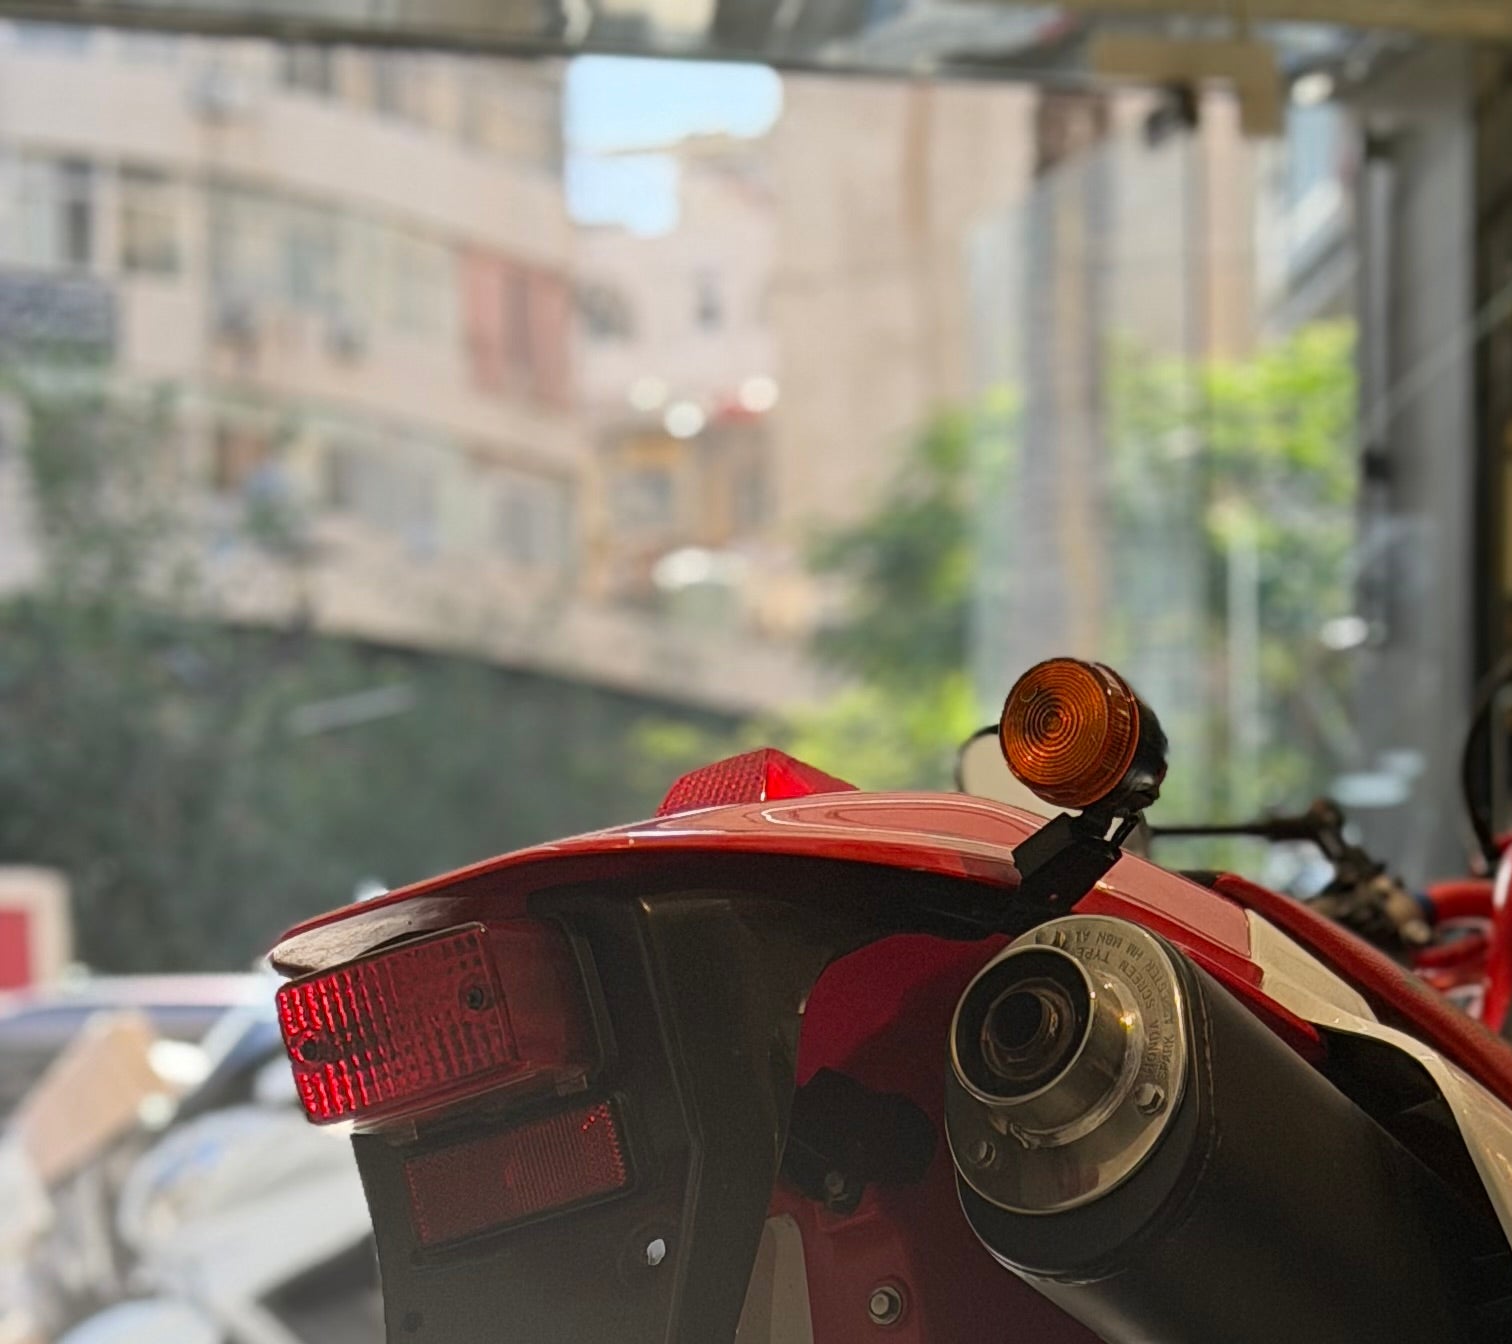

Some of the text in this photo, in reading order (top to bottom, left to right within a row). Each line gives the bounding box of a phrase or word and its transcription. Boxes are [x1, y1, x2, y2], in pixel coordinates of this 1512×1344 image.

[1074, 946, 1160, 1074] HONDA SCREEN TYPE
